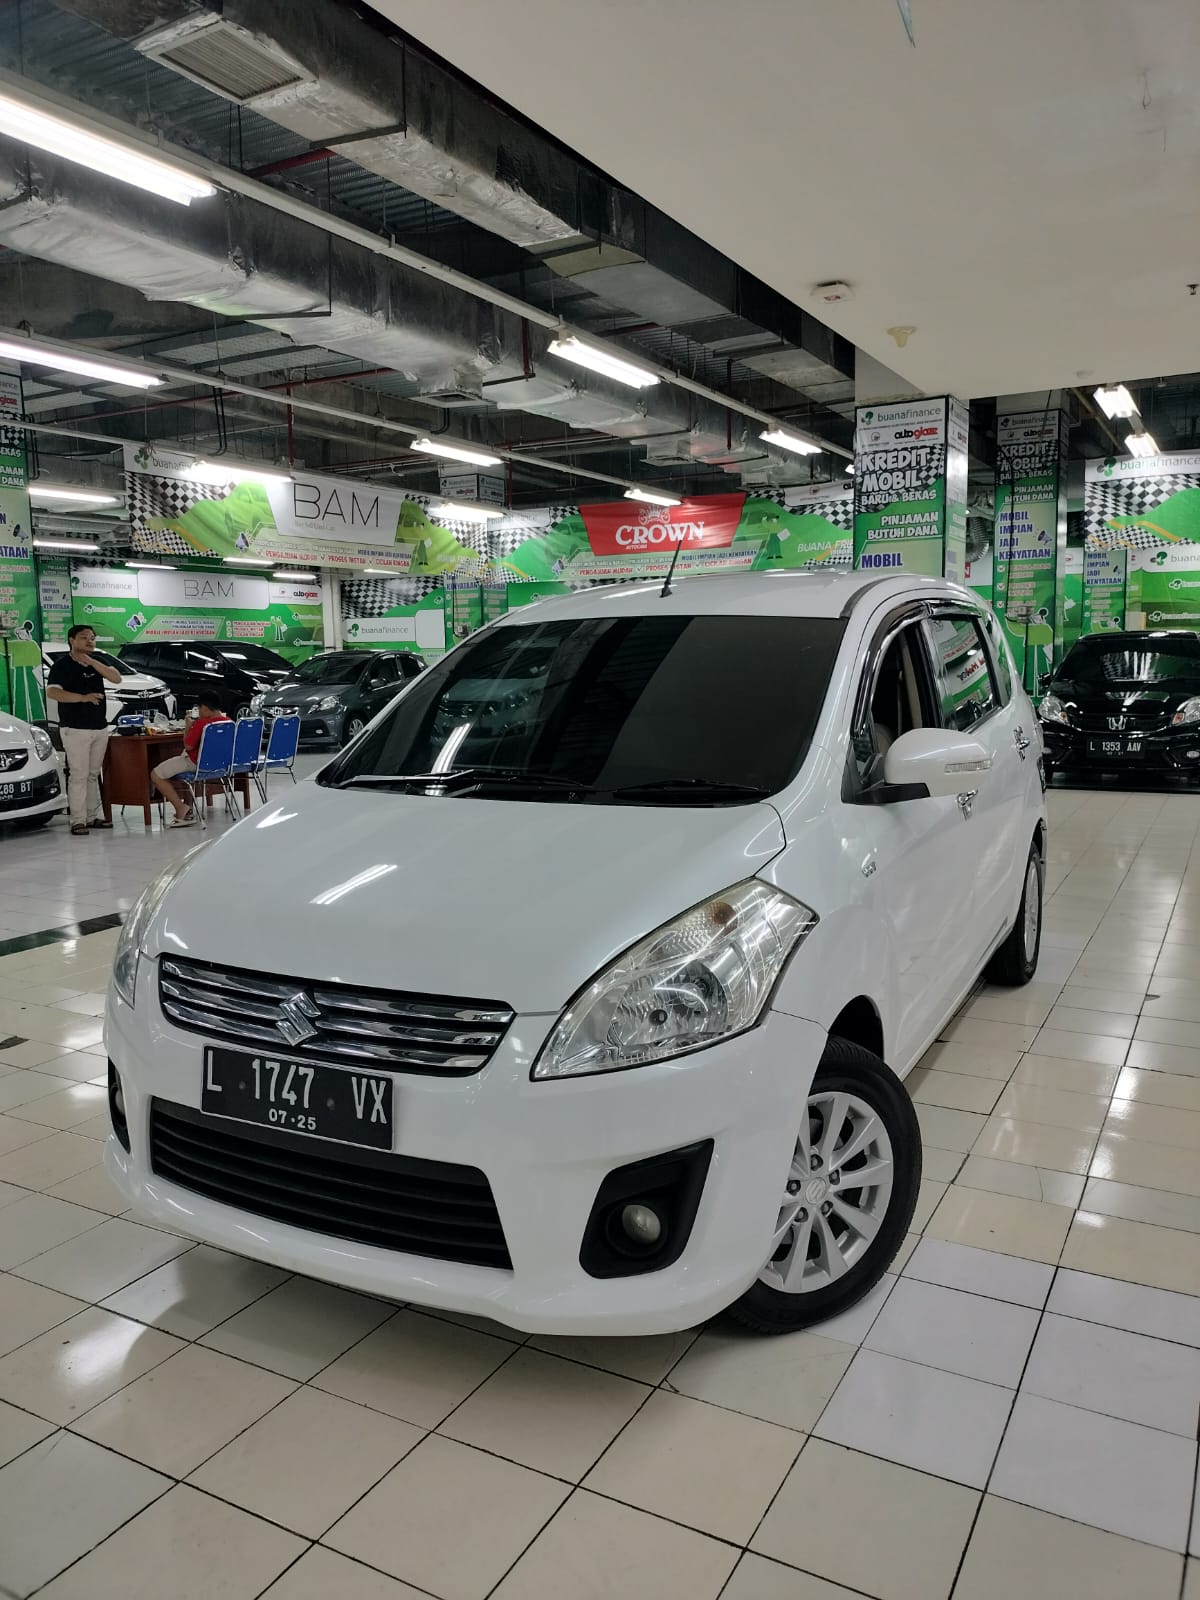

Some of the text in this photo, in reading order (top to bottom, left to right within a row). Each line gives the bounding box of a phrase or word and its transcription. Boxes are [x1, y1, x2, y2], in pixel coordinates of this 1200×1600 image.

[877, 407, 941, 422] buanafinance
[1001, 442, 1049, 457] KREDIT
[861, 448, 931, 473] KREDIT
[1000, 457, 1042, 471] MOBIL
[862, 469, 922, 492] MOBIL
[861, 493, 888, 506] BARU
[902, 489, 937, 502] BEKAS
[294, 483, 380, 528] BAM
[881, 511, 939, 526] PINJAMAN
[1000, 511, 1029, 522] MOBIL
[615, 521, 705, 546] CROWN
[868, 527, 905, 540] BUTUH
[907, 525, 939, 537] DANA
[1000, 524, 1033, 535] IMPIAN
[797, 541, 832, 553] BUANA
[1000, 537, 1019, 548] JADI
[861, 553, 903, 569] MOBIL
[999, 549, 1051, 561] KENYATAAN
[580, 568, 612, 576] PENGAJUAN
[82, 580, 133, 591] buanafinance
[184, 579, 234, 598] BAM
[361, 625, 409, 635] buanafinance
[1090, 741, 1096, 751] L
[1102, 741, 1121, 751] 1353
[20, 781, 32, 793] BT
[207, 1050, 388, 1125] L 1747 VX
